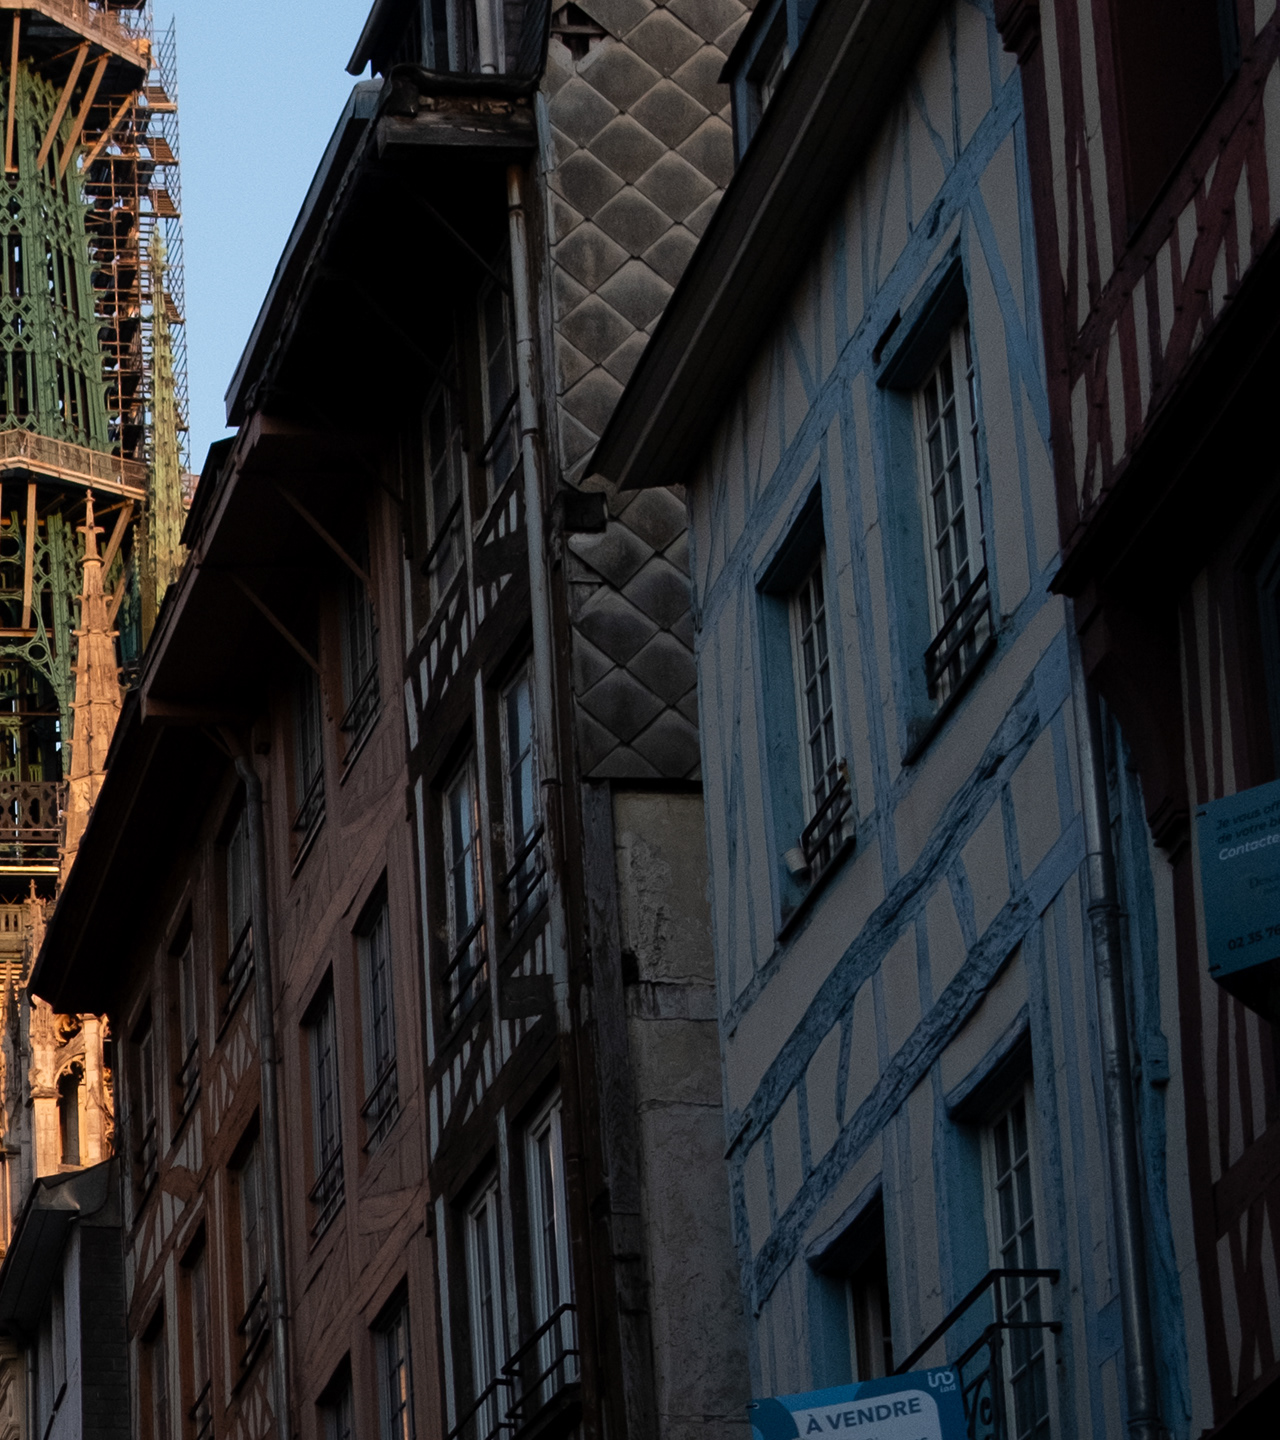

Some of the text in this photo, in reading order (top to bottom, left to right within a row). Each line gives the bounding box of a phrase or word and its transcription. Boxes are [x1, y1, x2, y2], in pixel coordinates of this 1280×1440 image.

[1232, 809, 1261, 824] vous
[1235, 822, 1267, 838] votre
[1227, 936, 1245, 951] 02
[805, 1396, 922, 1435] À VENDRE
